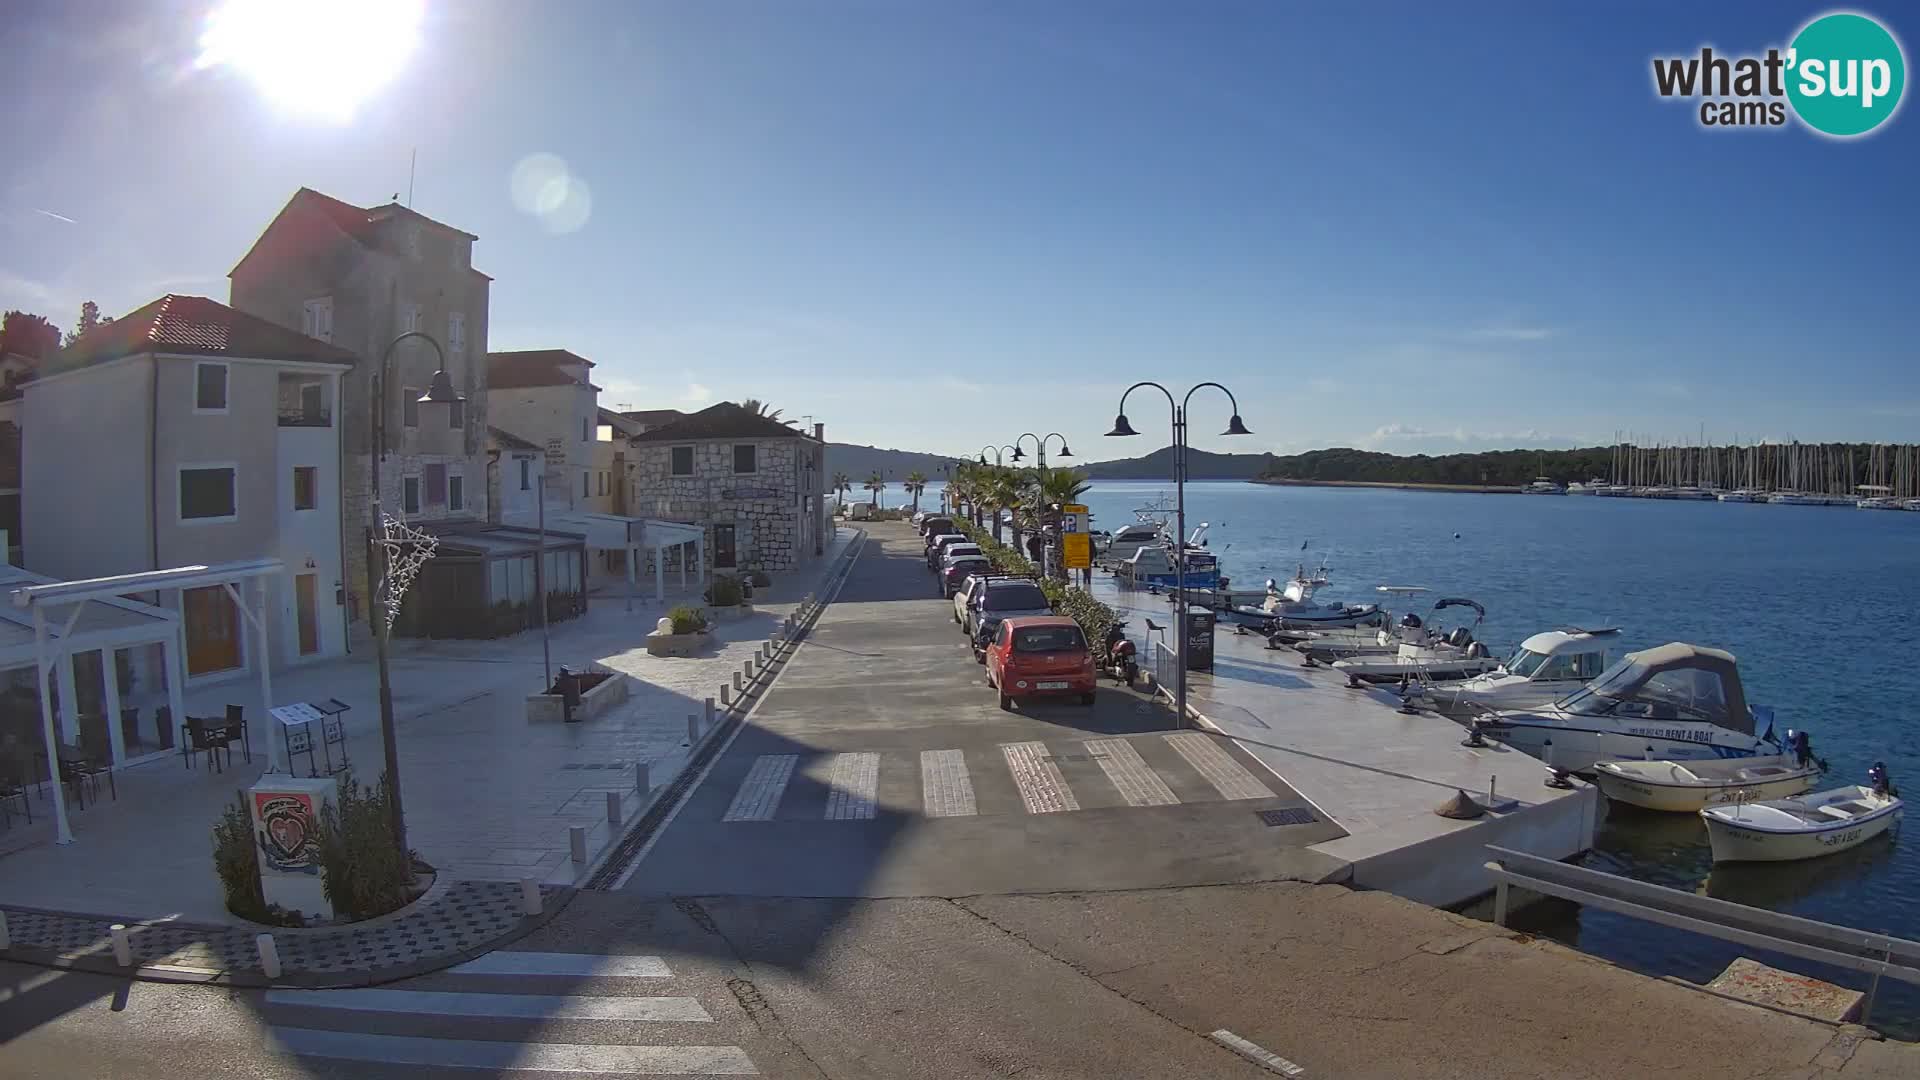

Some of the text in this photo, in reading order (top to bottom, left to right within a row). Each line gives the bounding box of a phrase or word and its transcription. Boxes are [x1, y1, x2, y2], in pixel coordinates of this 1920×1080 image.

[1665, 729, 1685, 739] RENT
[1687, 730, 1692, 740] A
[1694, 731, 1714, 743] BOAT
[1744, 791, 1762, 801] BOAT
[1847, 829, 1862, 841] BOAT
